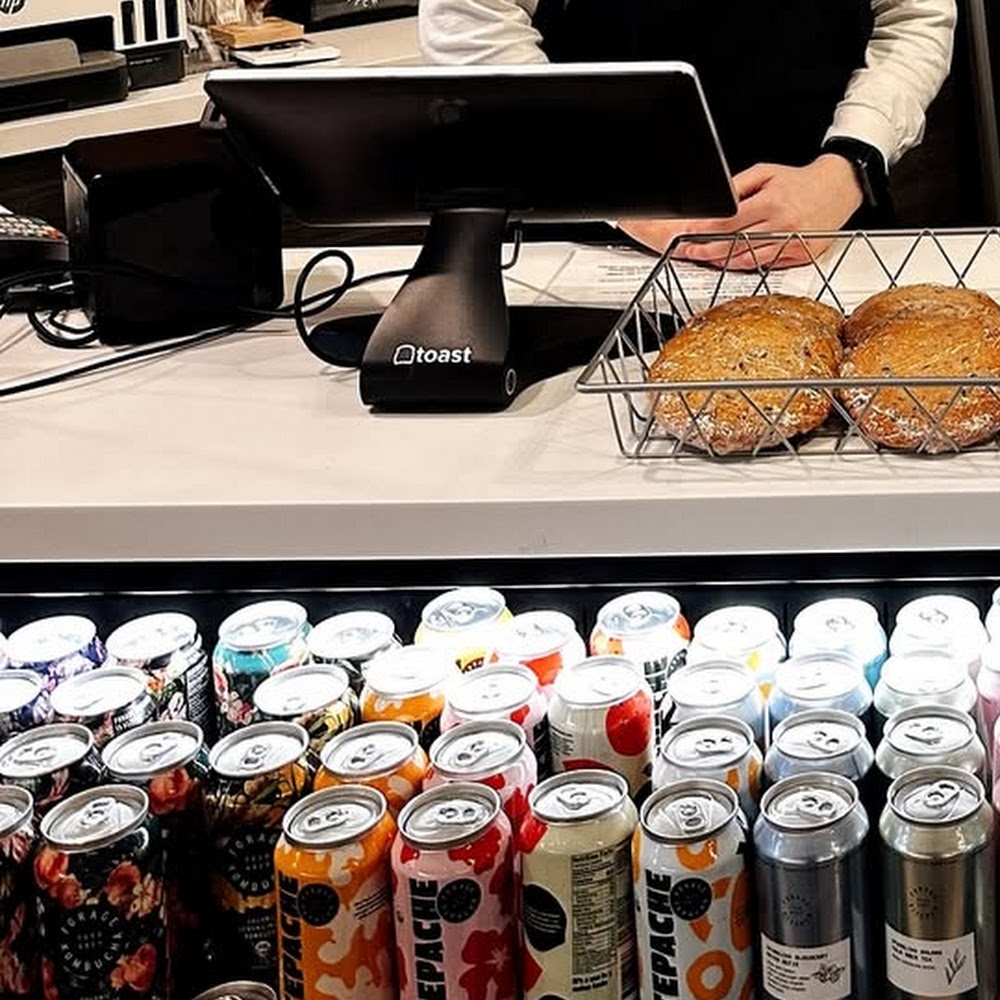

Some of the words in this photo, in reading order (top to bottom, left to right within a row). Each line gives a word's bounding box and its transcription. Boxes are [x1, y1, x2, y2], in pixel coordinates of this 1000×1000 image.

[416, 347, 472, 363] toast
[228, 832, 278, 857] FORAG
[409, 878, 447, 1000] EPACHE
